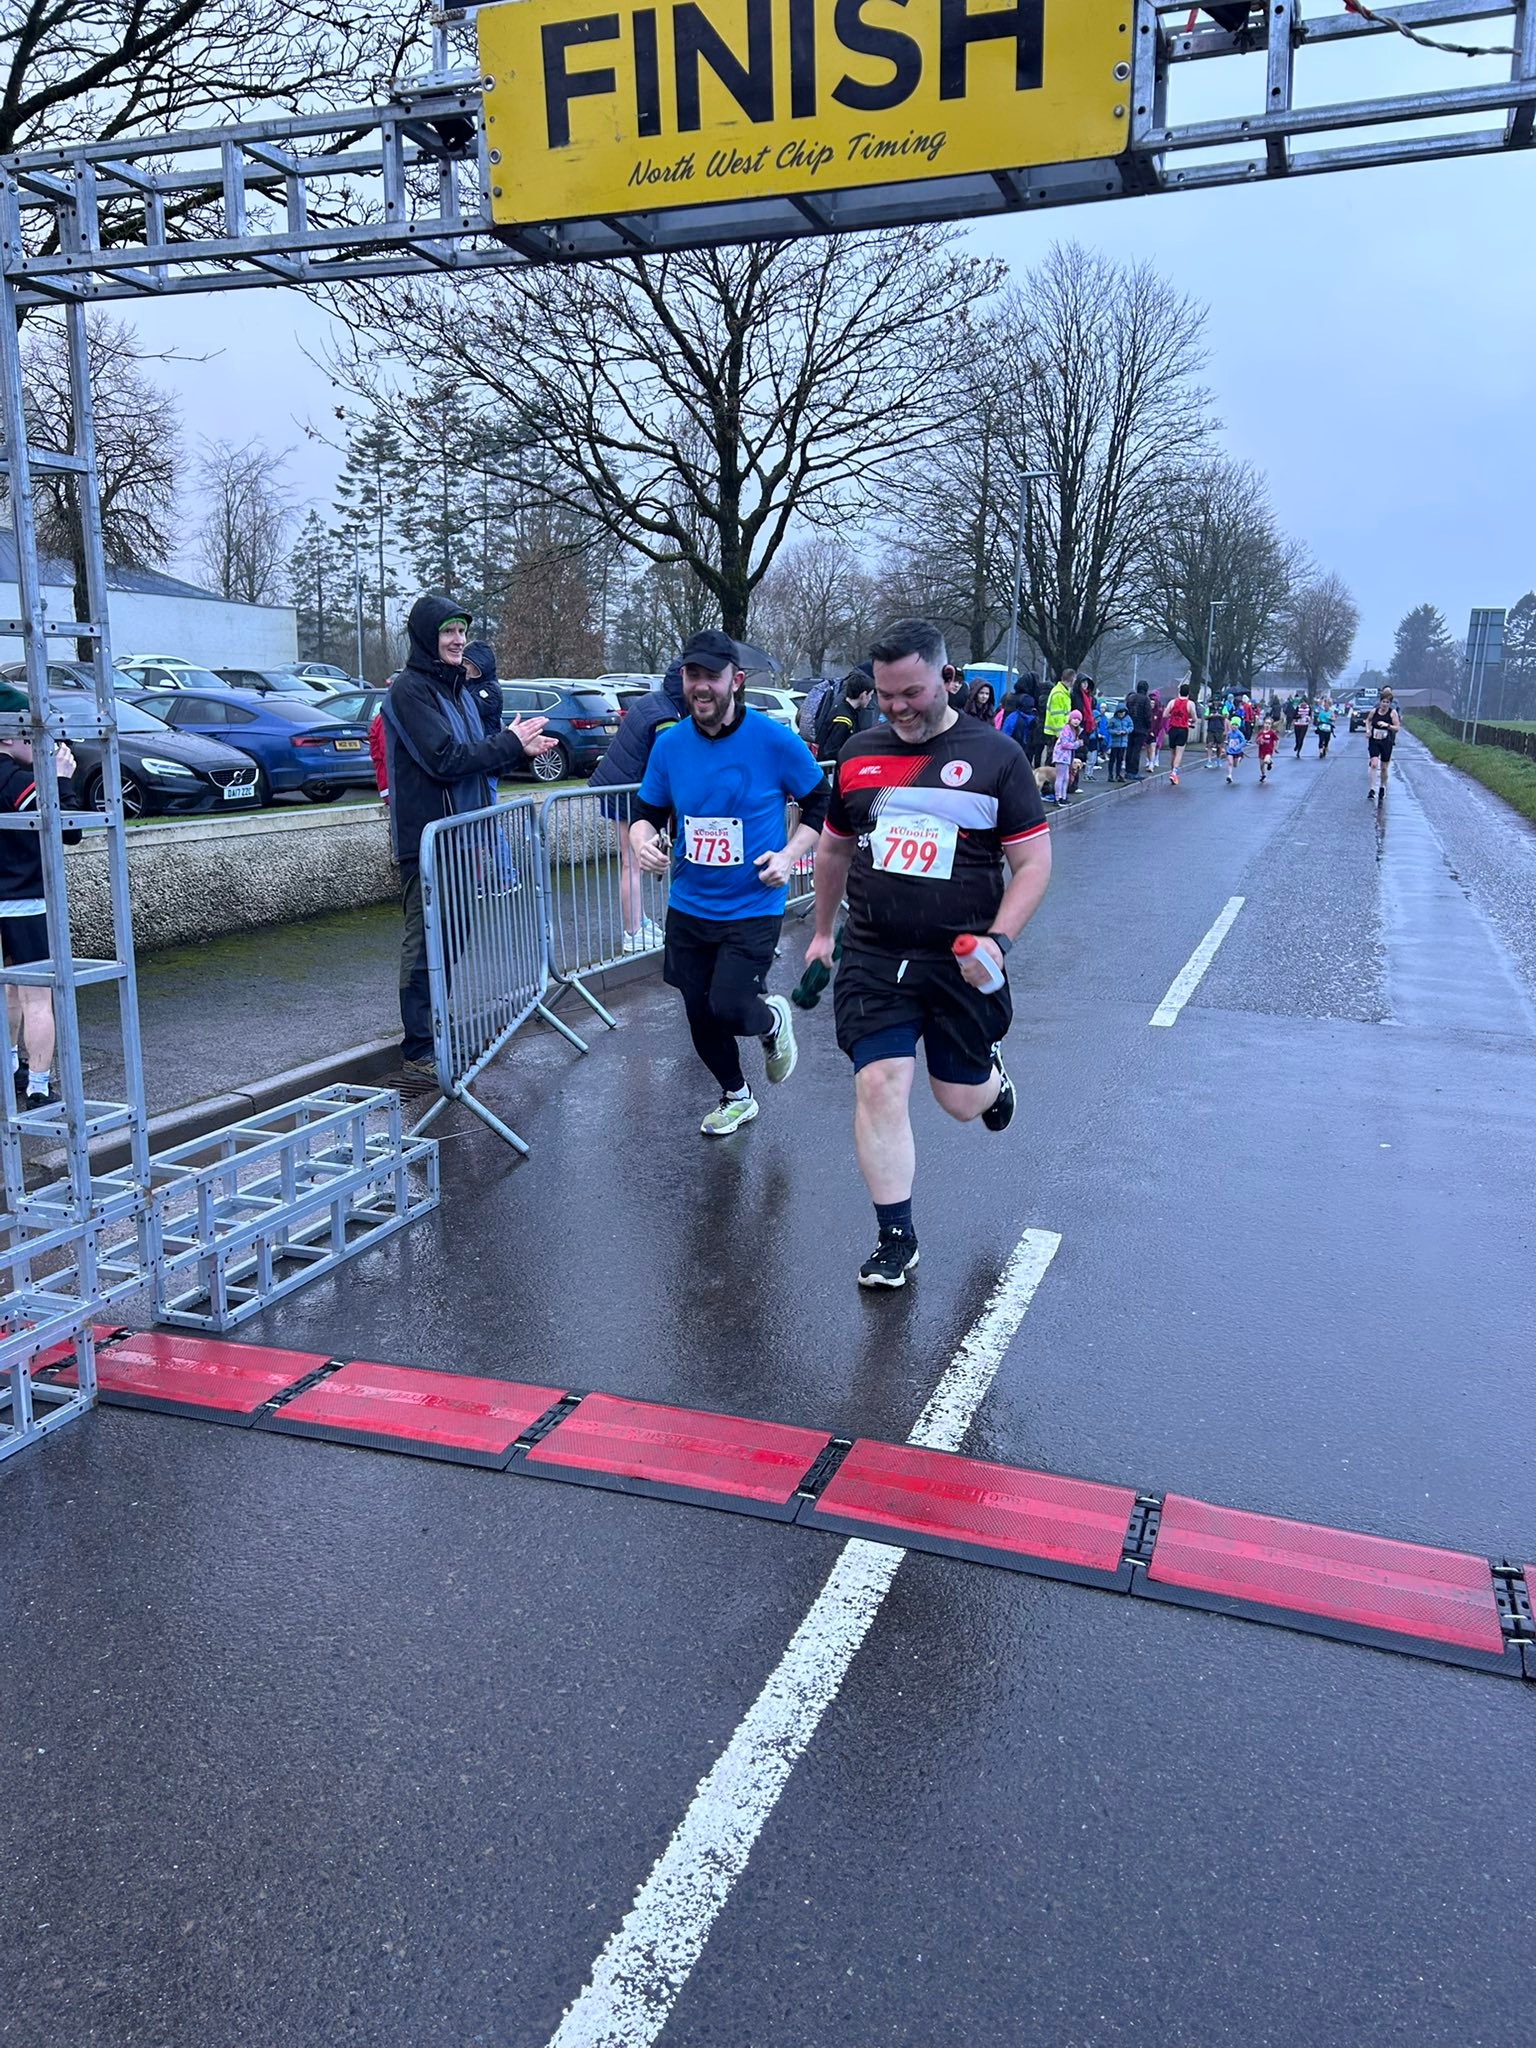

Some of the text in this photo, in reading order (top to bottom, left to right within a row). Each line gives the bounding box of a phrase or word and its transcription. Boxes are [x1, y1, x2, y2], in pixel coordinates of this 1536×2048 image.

[541, 0, 1044, 149] FINISH
[628, 130, 947, 187] North West Chip Timing
[693, 837, 731, 863] 773
[889, 826, 939, 840] RUDOLPH
[883, 837, 937, 873] 799
